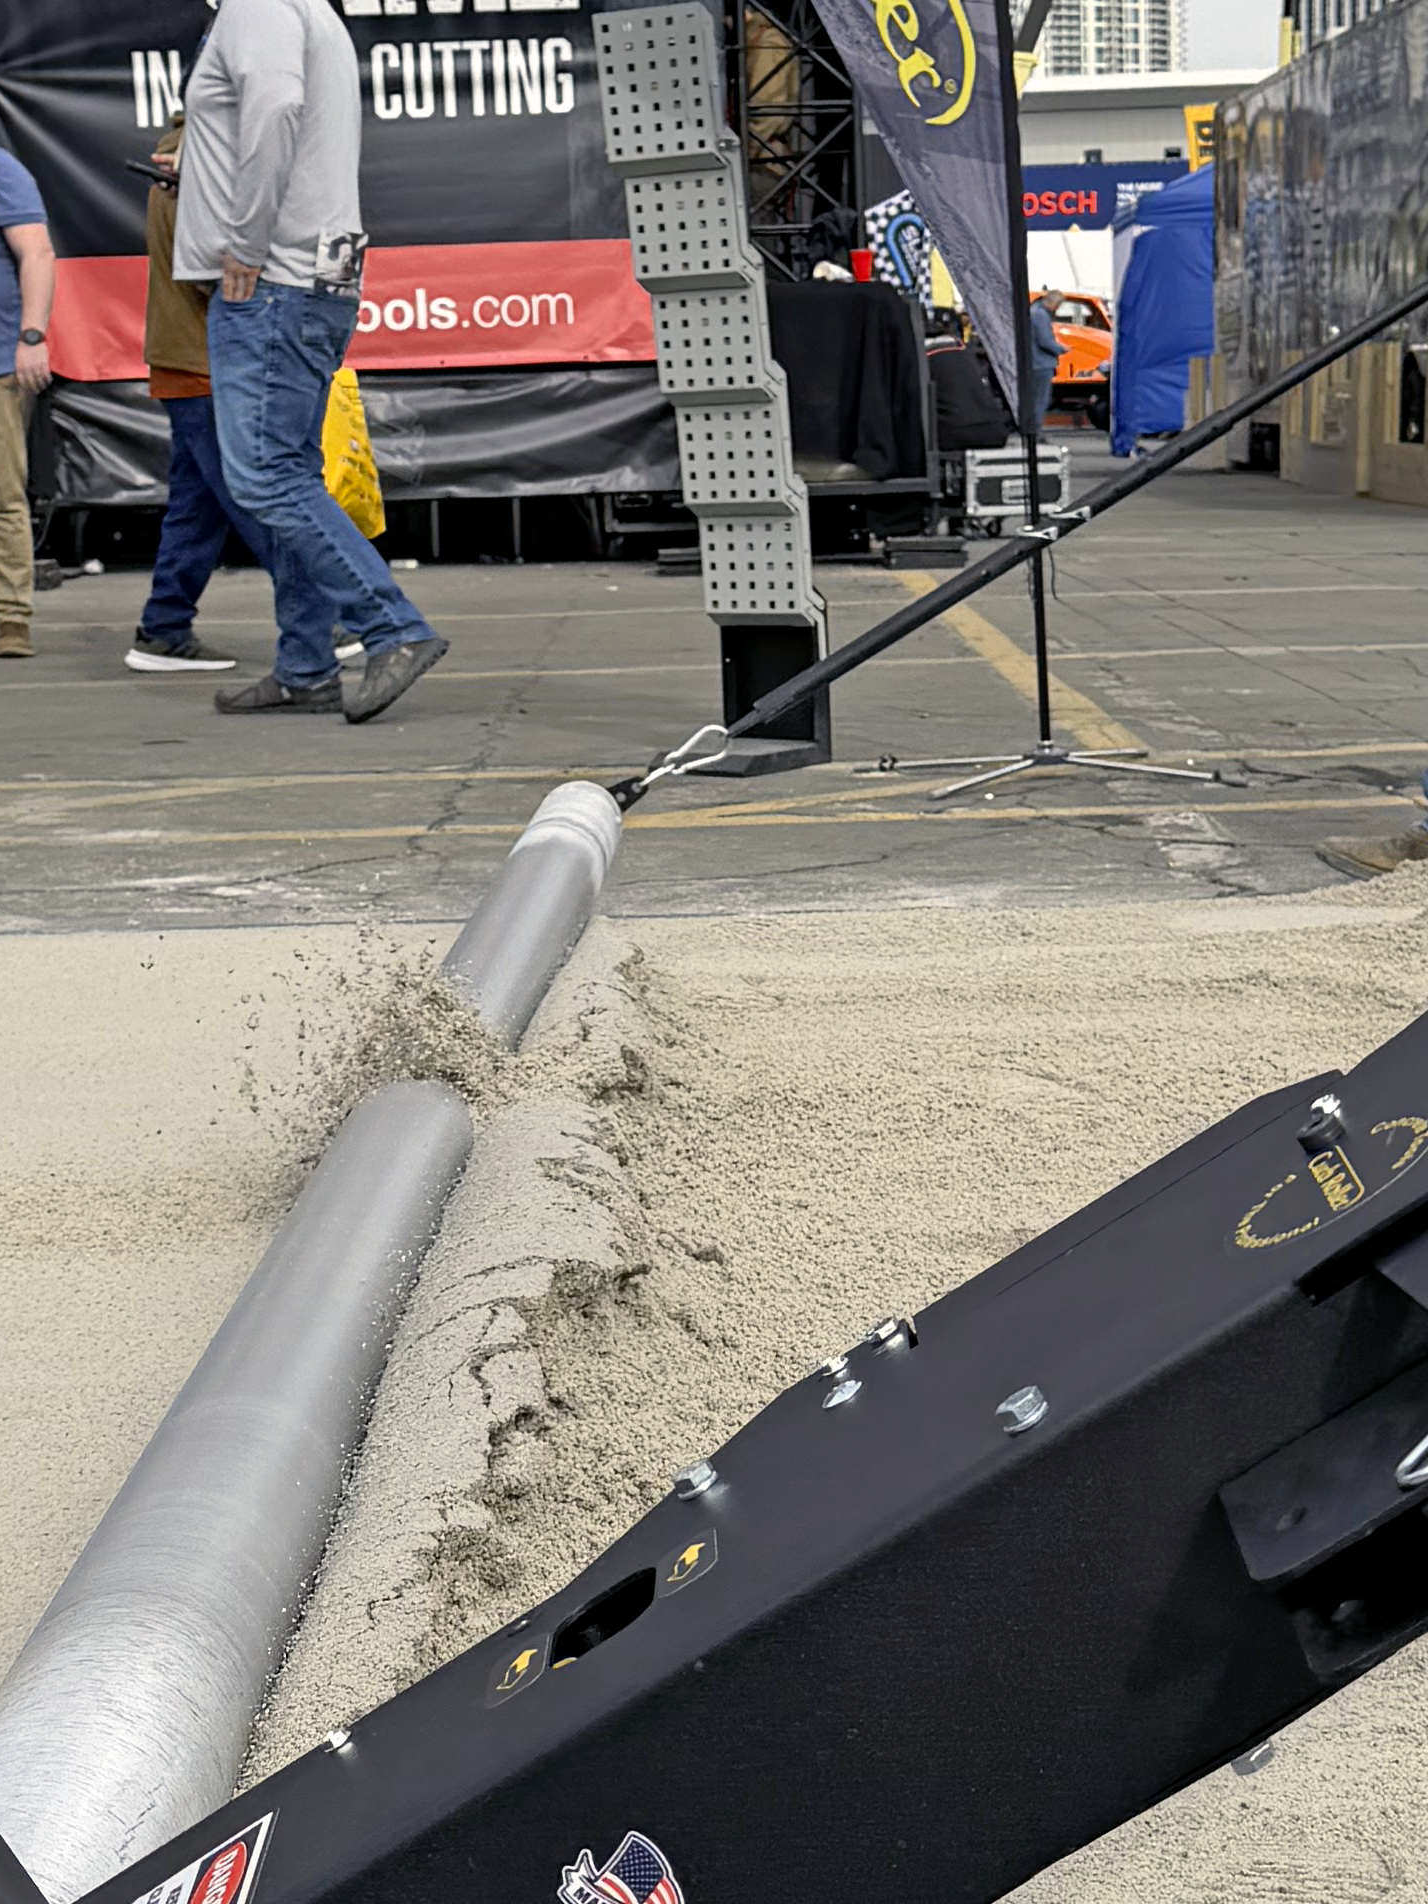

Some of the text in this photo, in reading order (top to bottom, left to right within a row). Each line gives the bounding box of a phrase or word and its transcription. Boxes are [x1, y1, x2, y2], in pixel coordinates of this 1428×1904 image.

[131, 37, 575, 129] IN CUTTING
[1022, 190, 1098, 217] OSCH
[356, 288, 574, 332] ools.com
